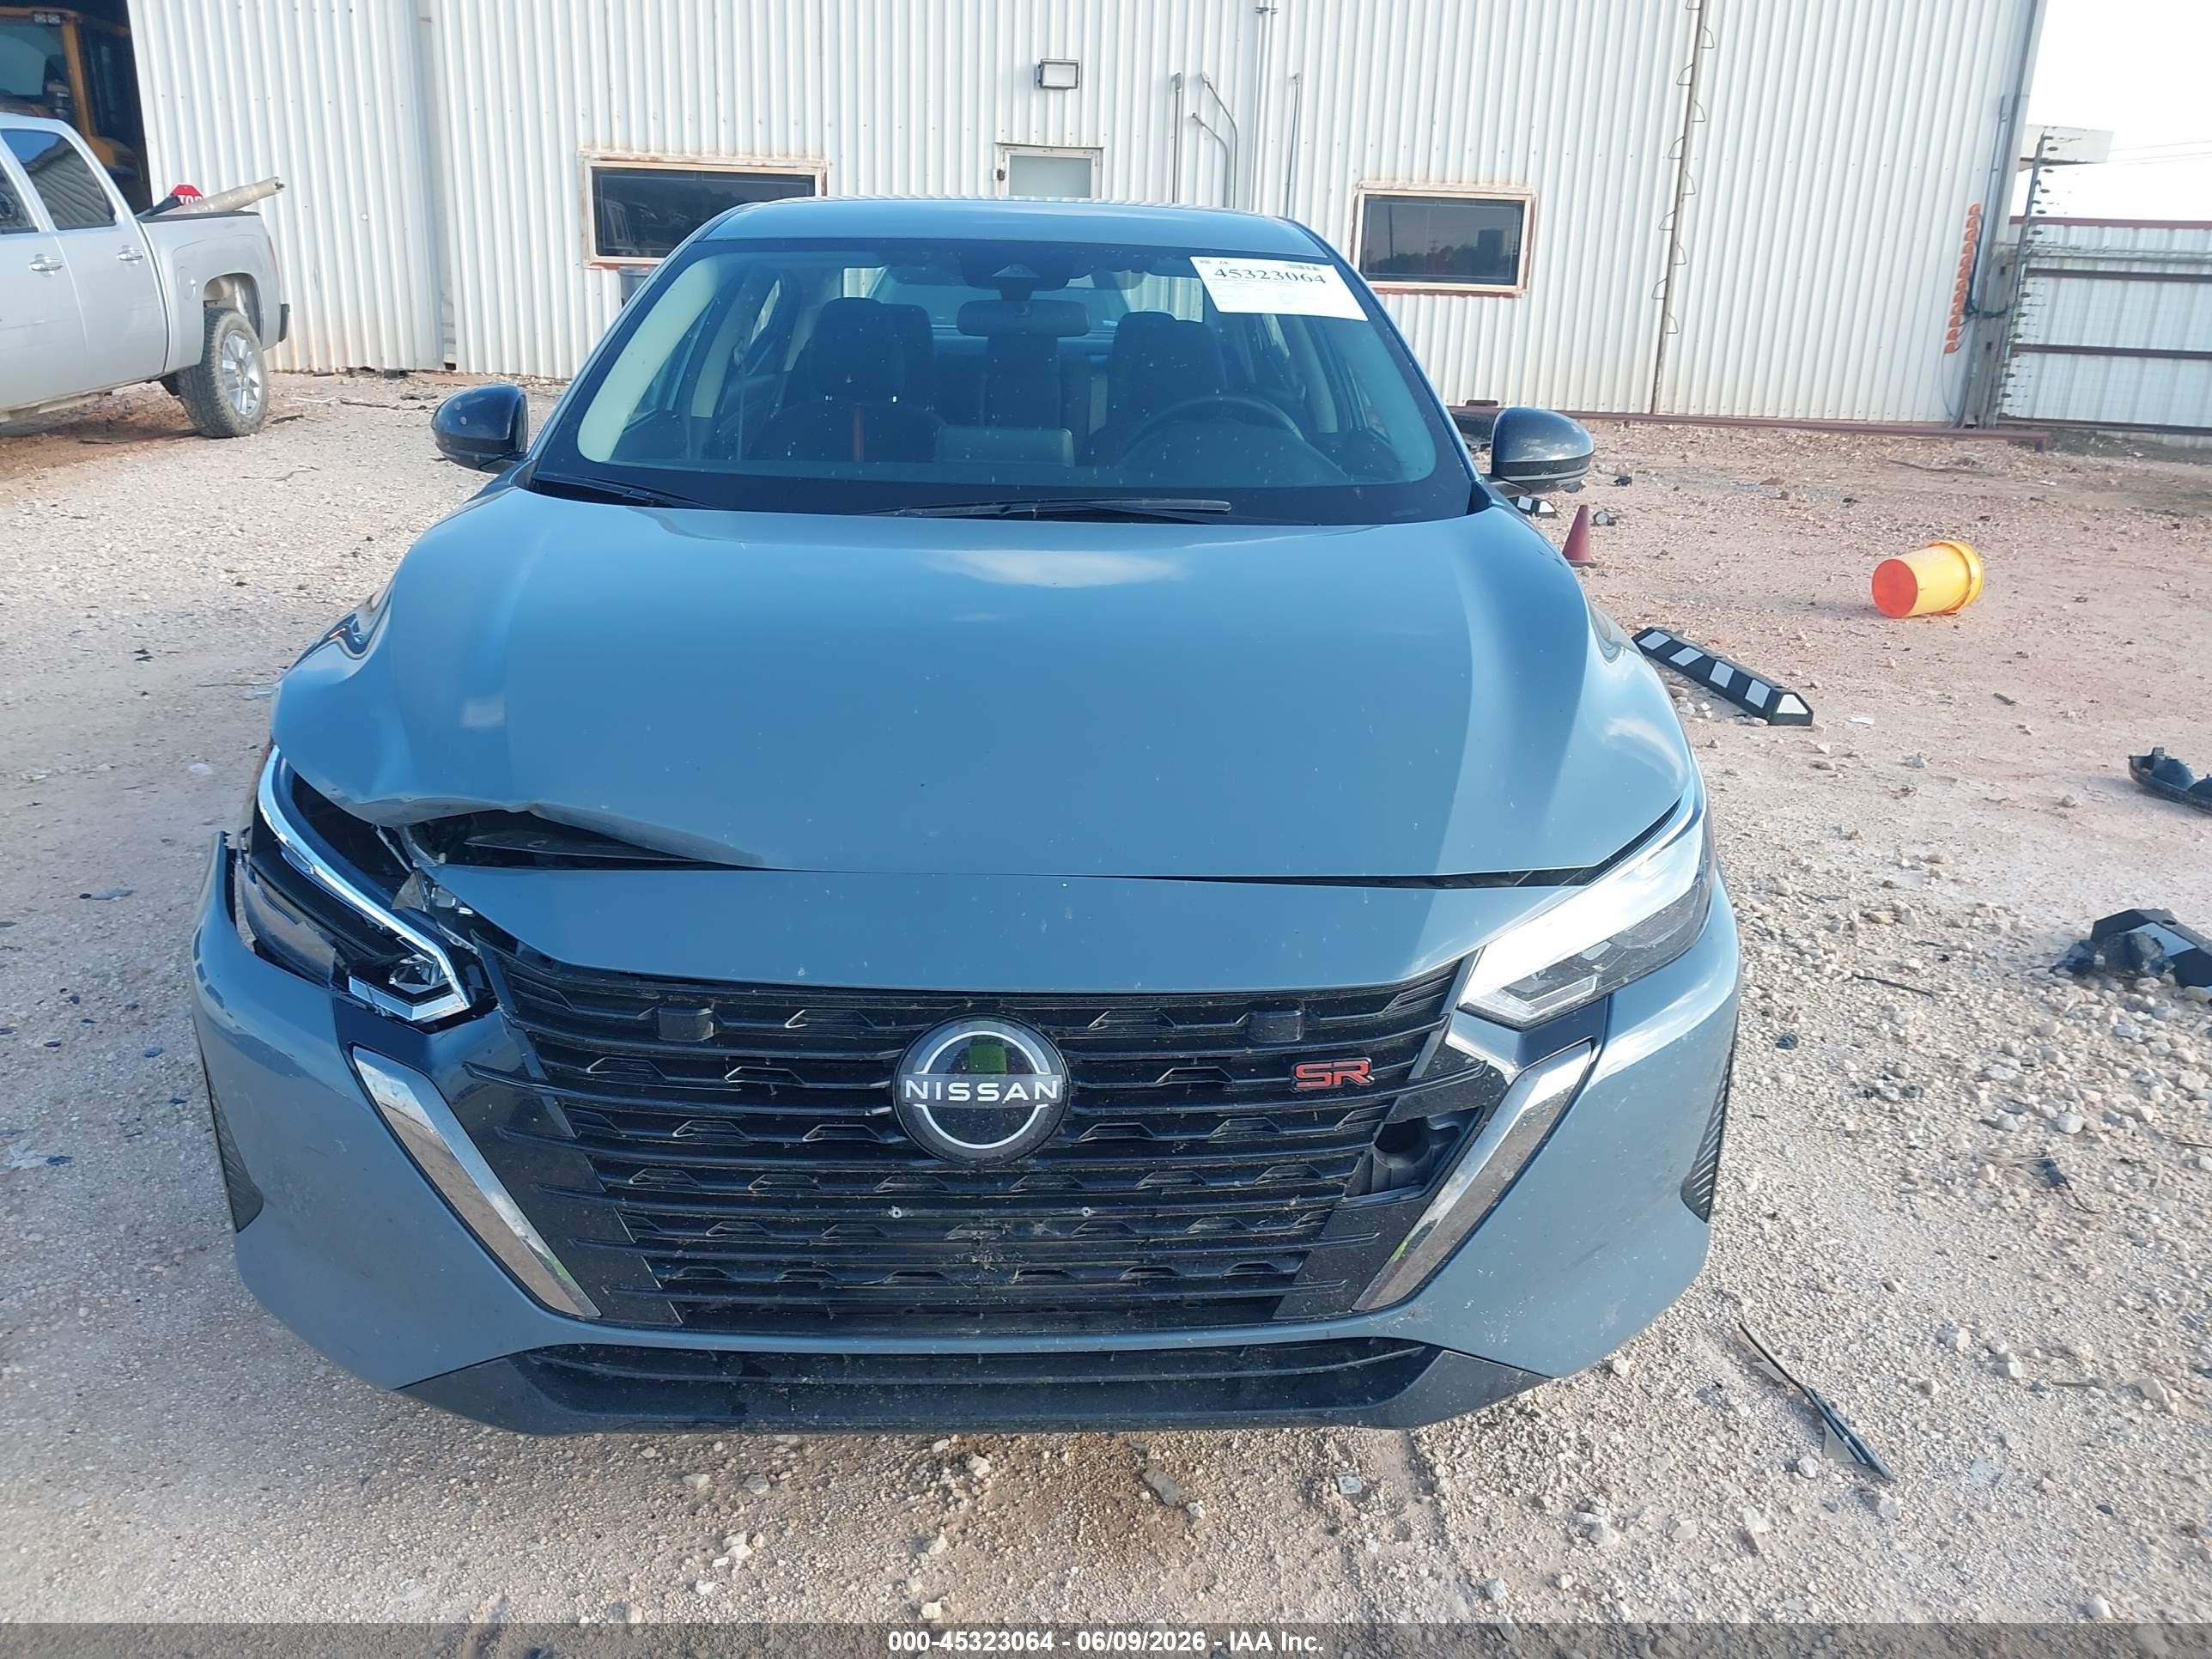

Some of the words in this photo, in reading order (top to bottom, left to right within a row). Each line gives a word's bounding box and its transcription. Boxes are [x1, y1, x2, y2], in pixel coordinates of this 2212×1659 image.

[178, 194, 203, 204] TO
[1214, 268, 1327, 284] 45323064
[1293, 1058, 1374, 1090] SR
[904, 1079, 1058, 1103] NISSAN
